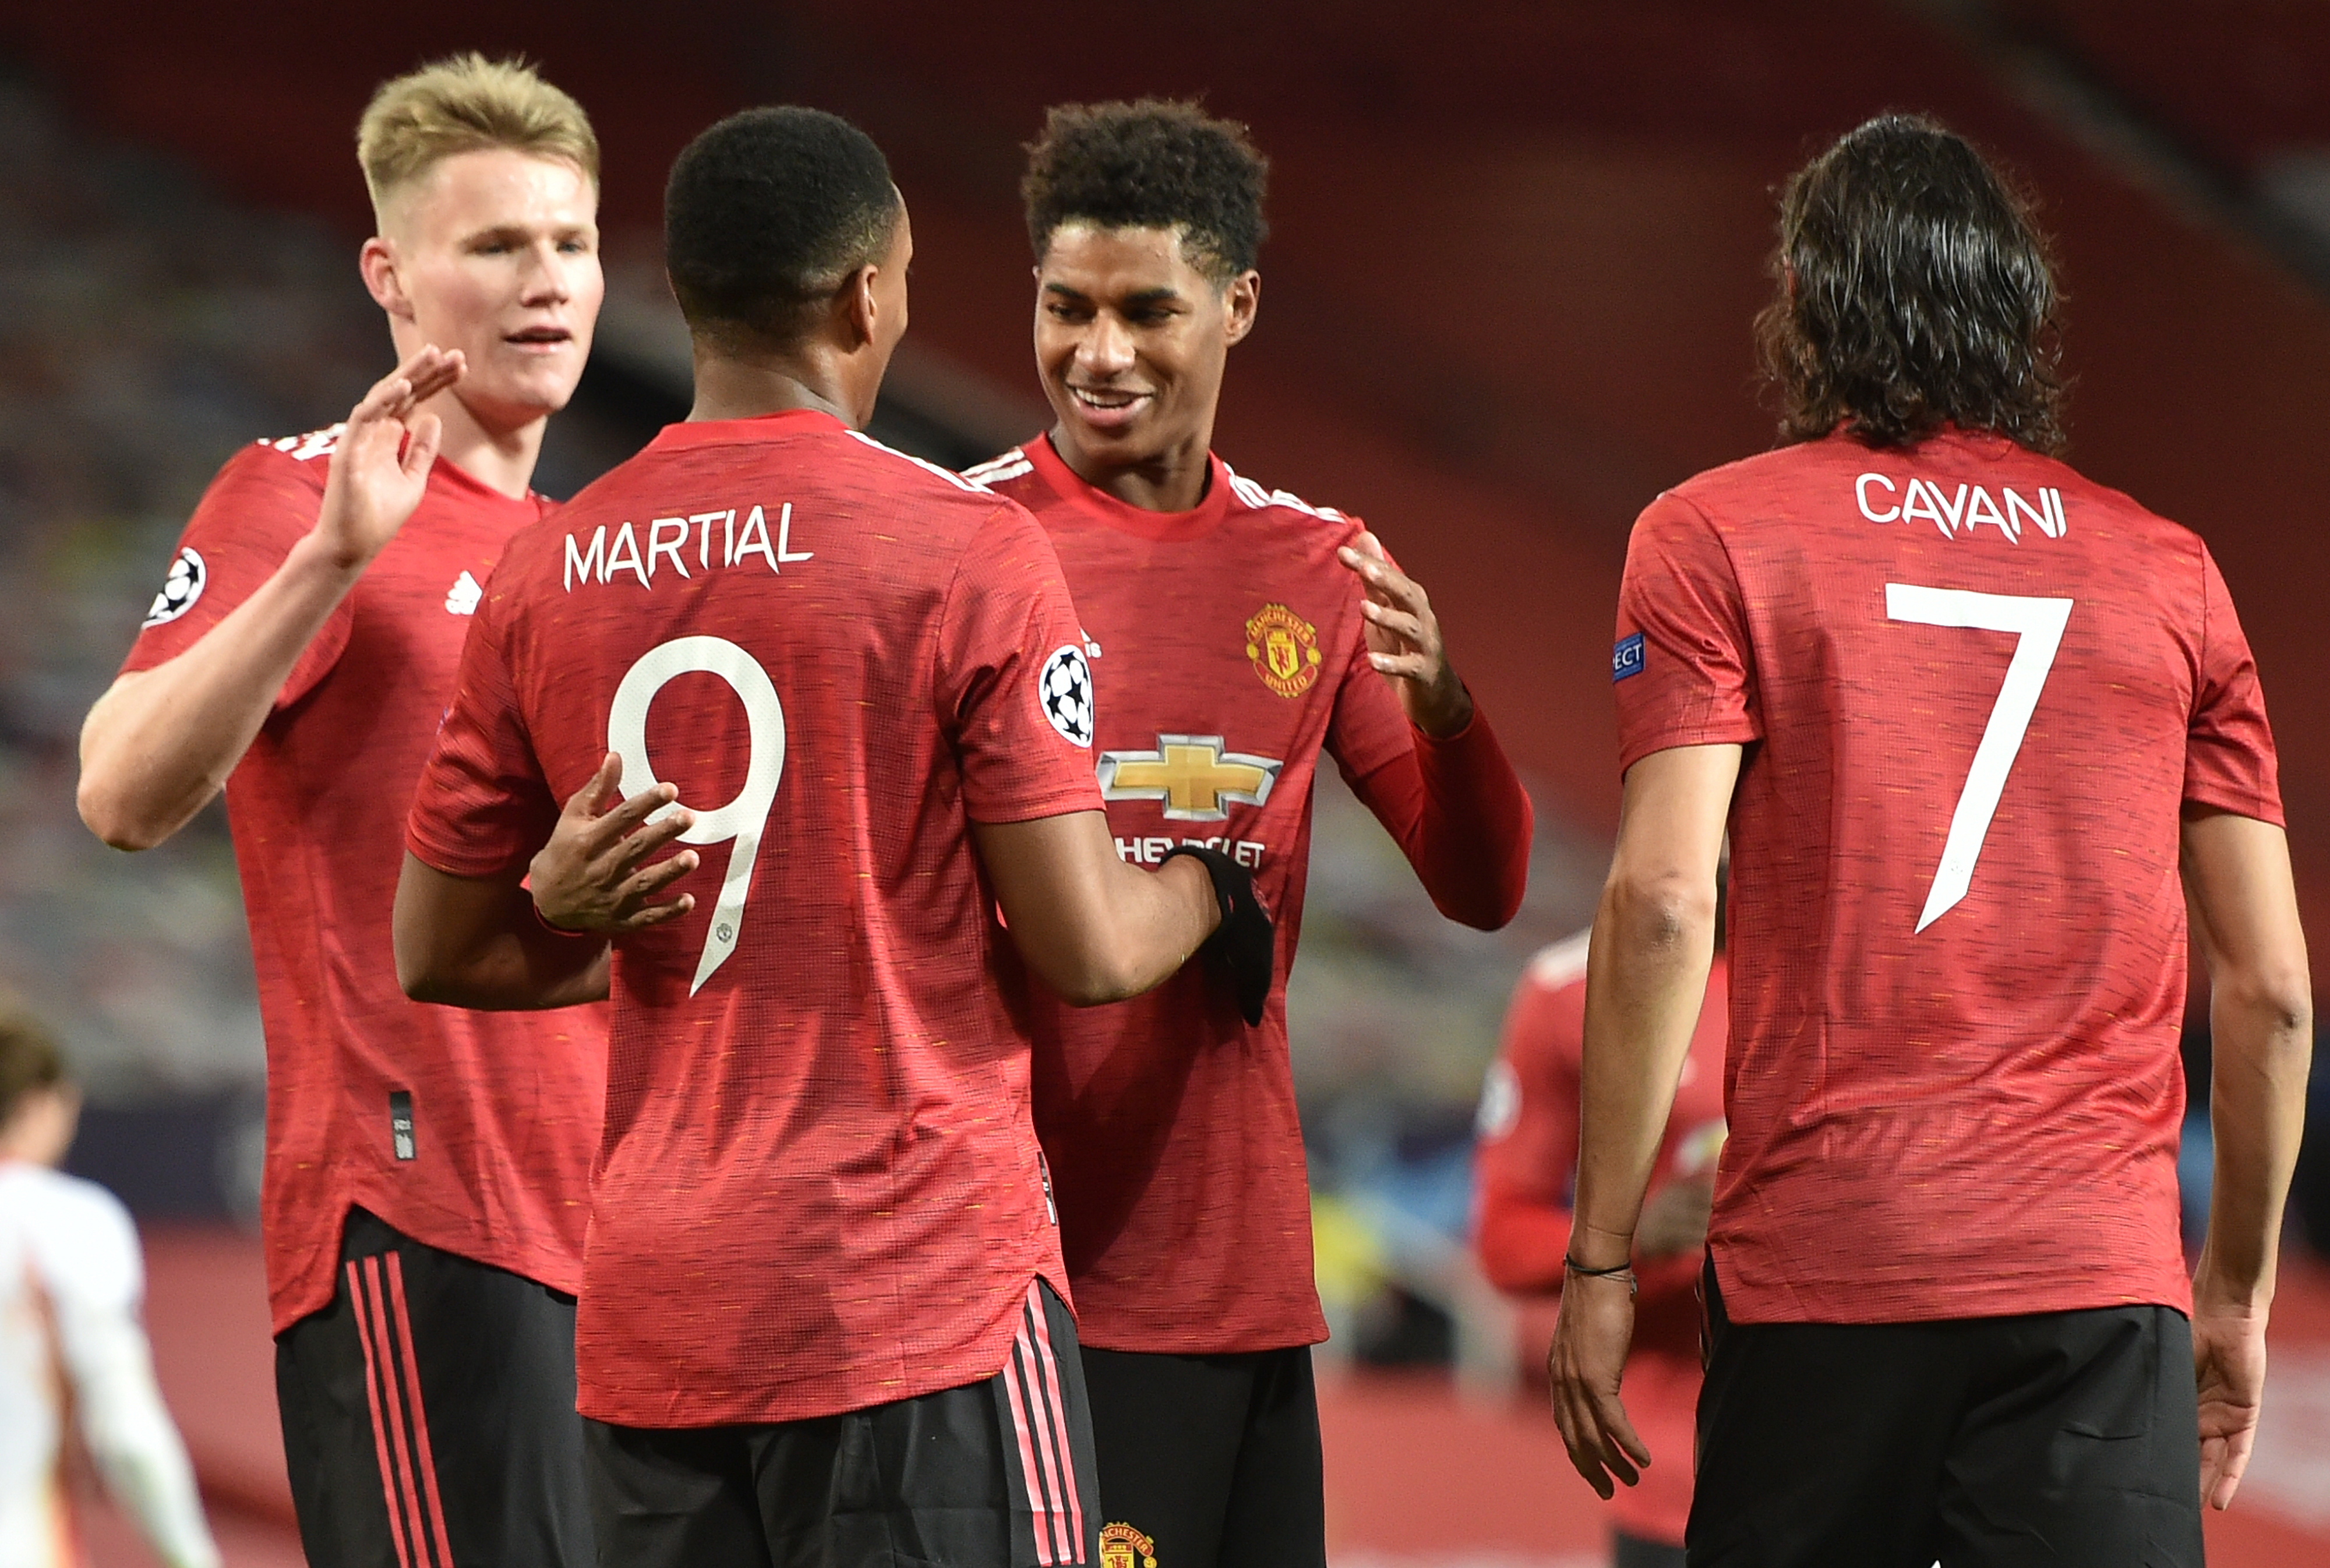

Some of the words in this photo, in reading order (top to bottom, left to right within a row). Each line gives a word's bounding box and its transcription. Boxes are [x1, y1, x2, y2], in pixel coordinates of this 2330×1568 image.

[563, 503, 814, 593] MARTIAL
[1855, 473, 2067, 545] CAVANI
[1613, 643, 1642, 670] ECT
[1885, 582, 2074, 935] 7
[608, 635, 785, 998] 9
